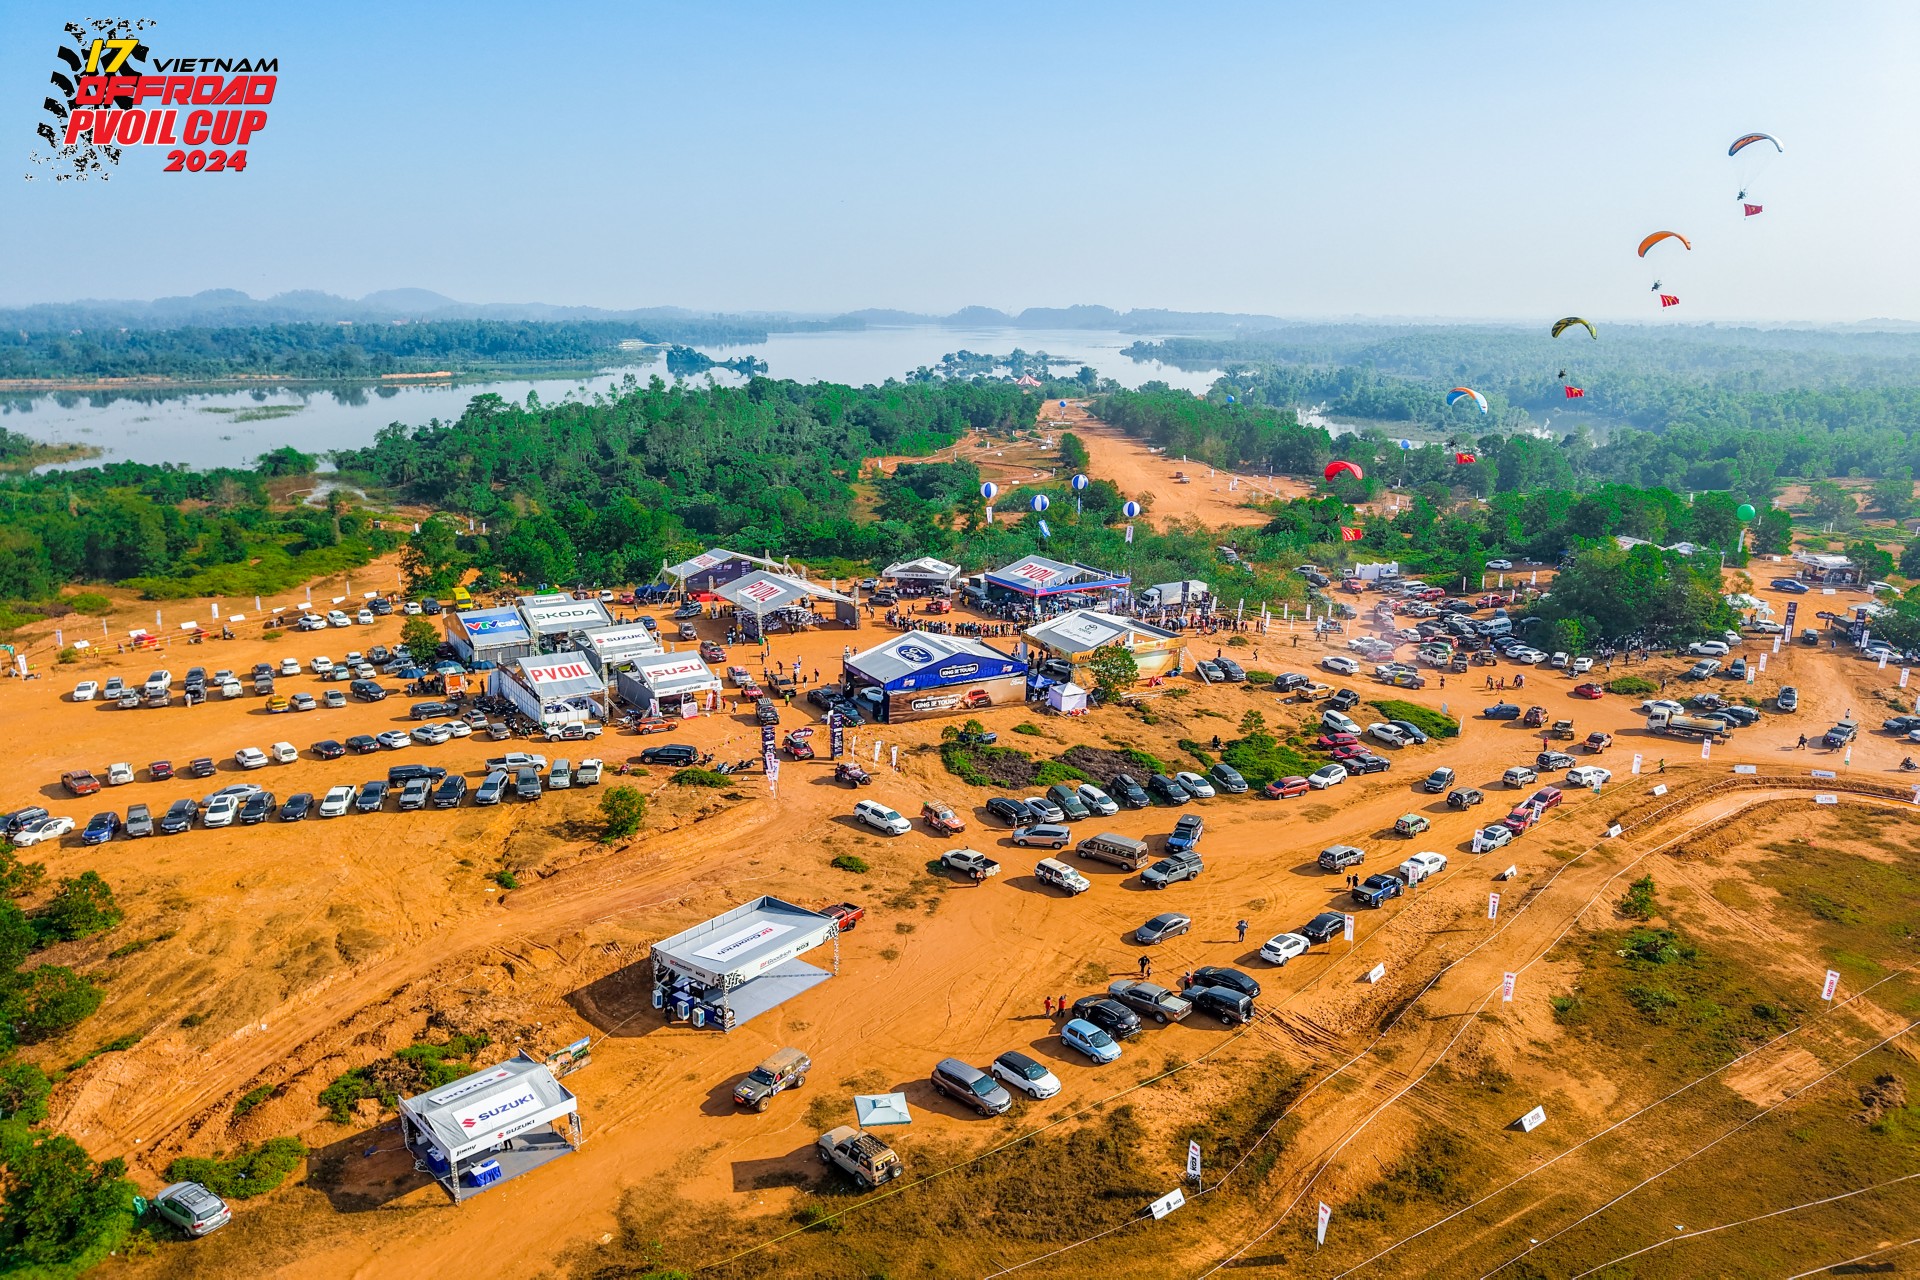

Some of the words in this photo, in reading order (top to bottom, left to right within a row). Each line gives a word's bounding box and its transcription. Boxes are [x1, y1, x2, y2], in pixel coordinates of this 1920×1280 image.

[1014, 564, 1056, 582] PVOIL
[741, 581, 780, 601] PVOIL
[465, 619, 520, 631] VTVcab
[606, 633, 646, 643] SUZUKI
[530, 663, 591, 682] PVOIL
[646, 664, 703, 678] ISUZU
[960, 666, 976, 674] TOUGH
[938, 698, 959, 706] TOUGH
[478, 1093, 535, 1121] SUZUKI
[505, 1119, 535, 1135] SUZUKI
